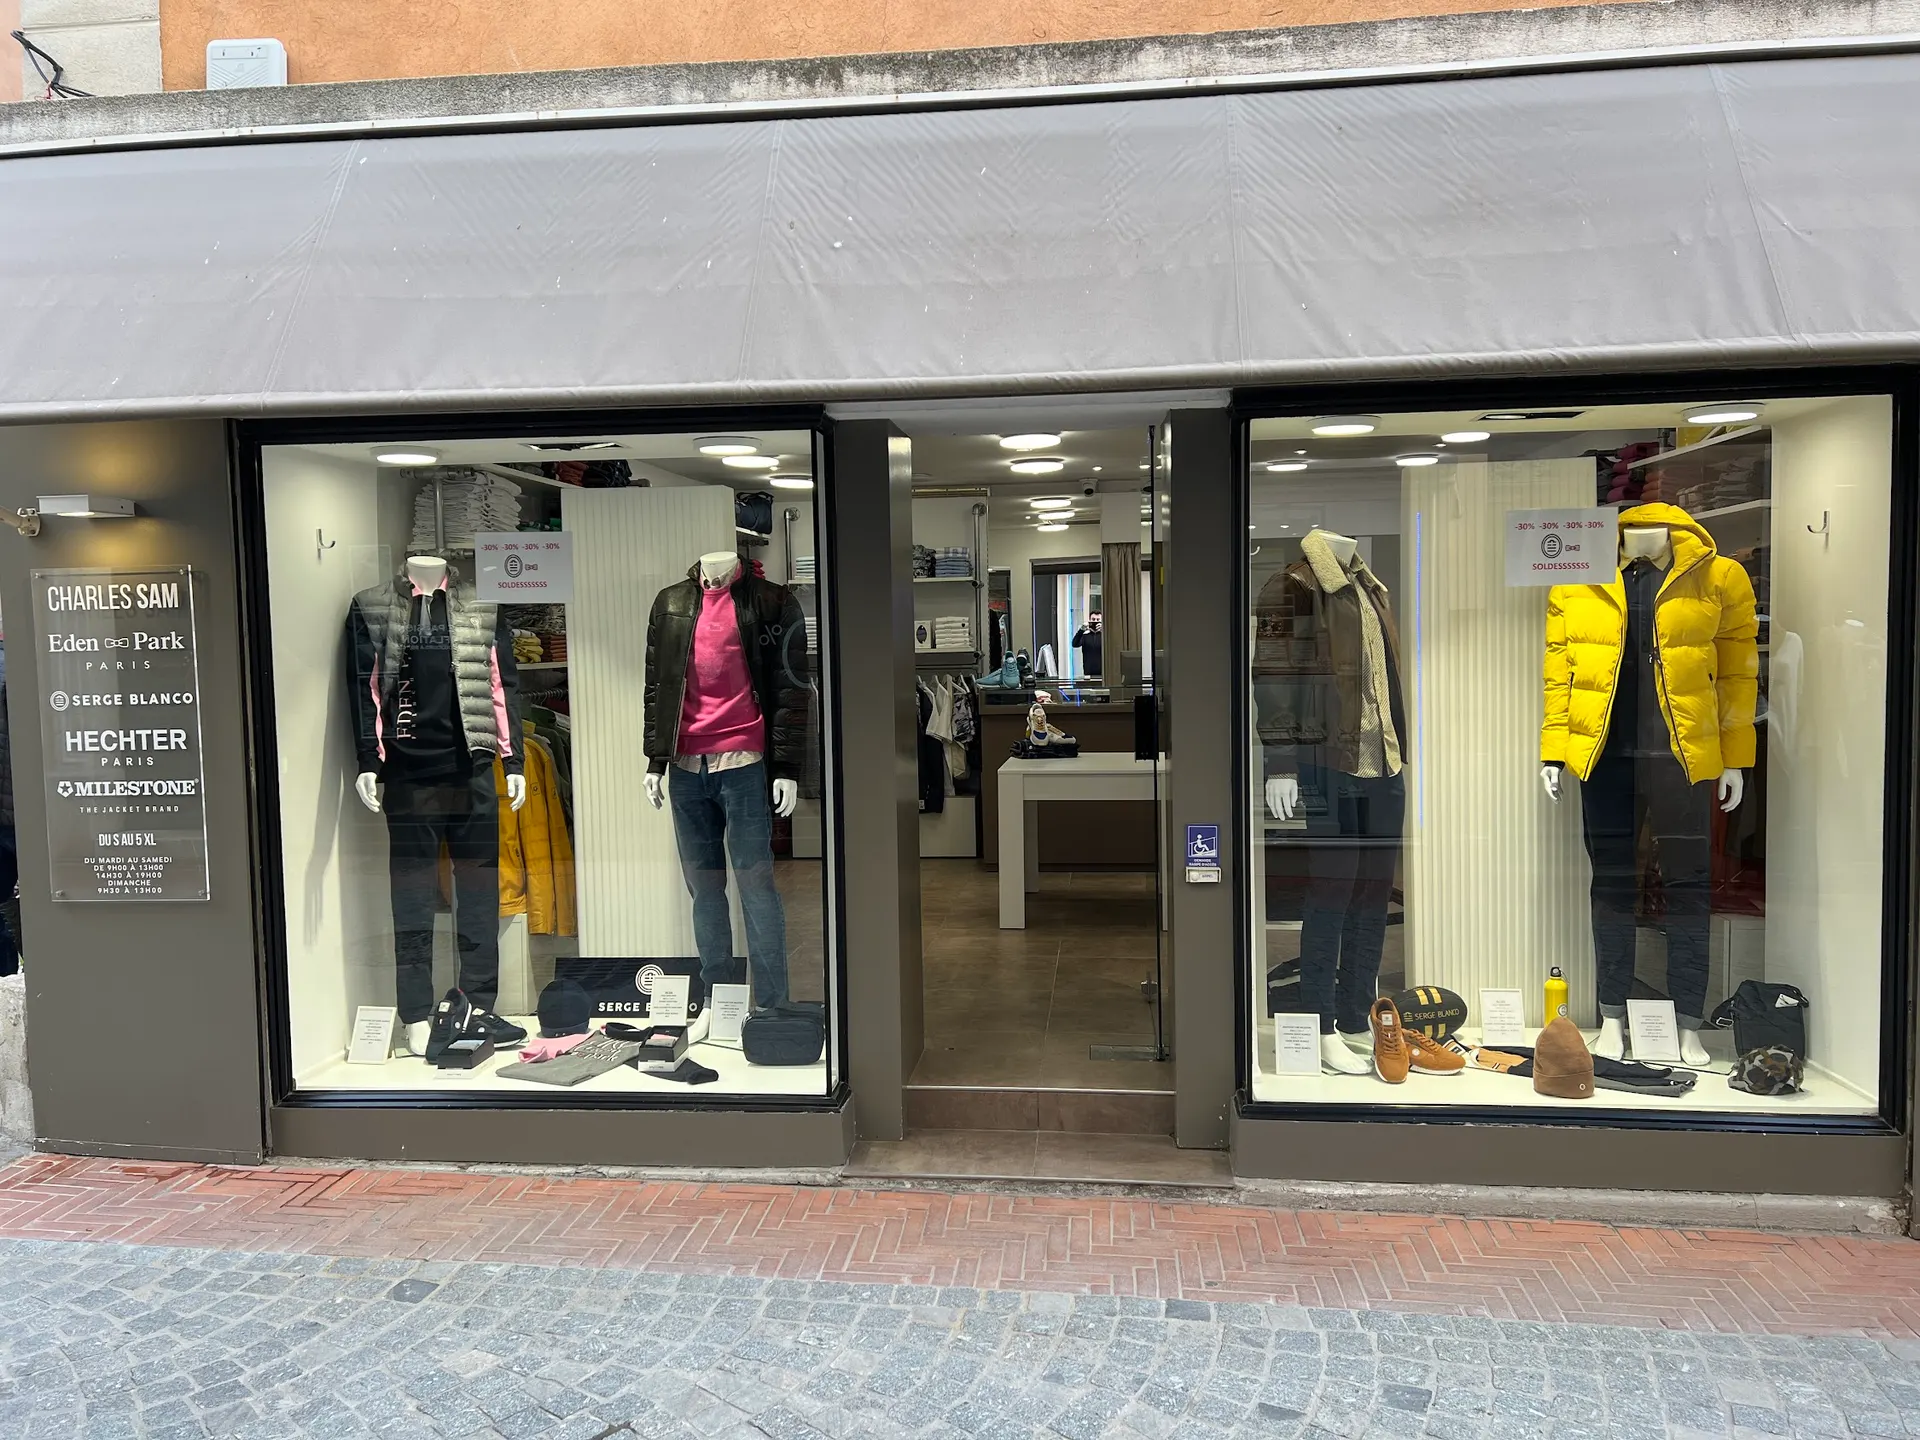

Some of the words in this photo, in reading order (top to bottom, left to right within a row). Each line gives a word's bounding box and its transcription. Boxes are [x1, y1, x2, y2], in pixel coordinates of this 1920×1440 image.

[1539, 522, 1559, 530] -30%
[48, 584, 132, 612] CHARLES
[136, 583, 179, 608] SAM
[48, 634, 100, 652] Eden
[132, 631, 185, 650] Park
[86, 660, 150, 670] PARIS
[72, 694, 122, 706] SERGE
[130, 692, 194, 705] BLANCO
[65, 729, 187, 752] HECHTER
[101, 756, 154, 766] PARIS
[74, 780, 196, 796] MILESTONE
[98, 834, 111, 846] DU
[113, 833, 119, 846] S
[121, 833, 134, 846] AU
[135, 833, 142, 845] 5
[144, 833, 156, 845] XL
[598, 1002, 640, 1012] SERGE
[1414, 1012, 1436, 1020] SERGE
[1437, 1008, 1460, 1018] BLANCO
